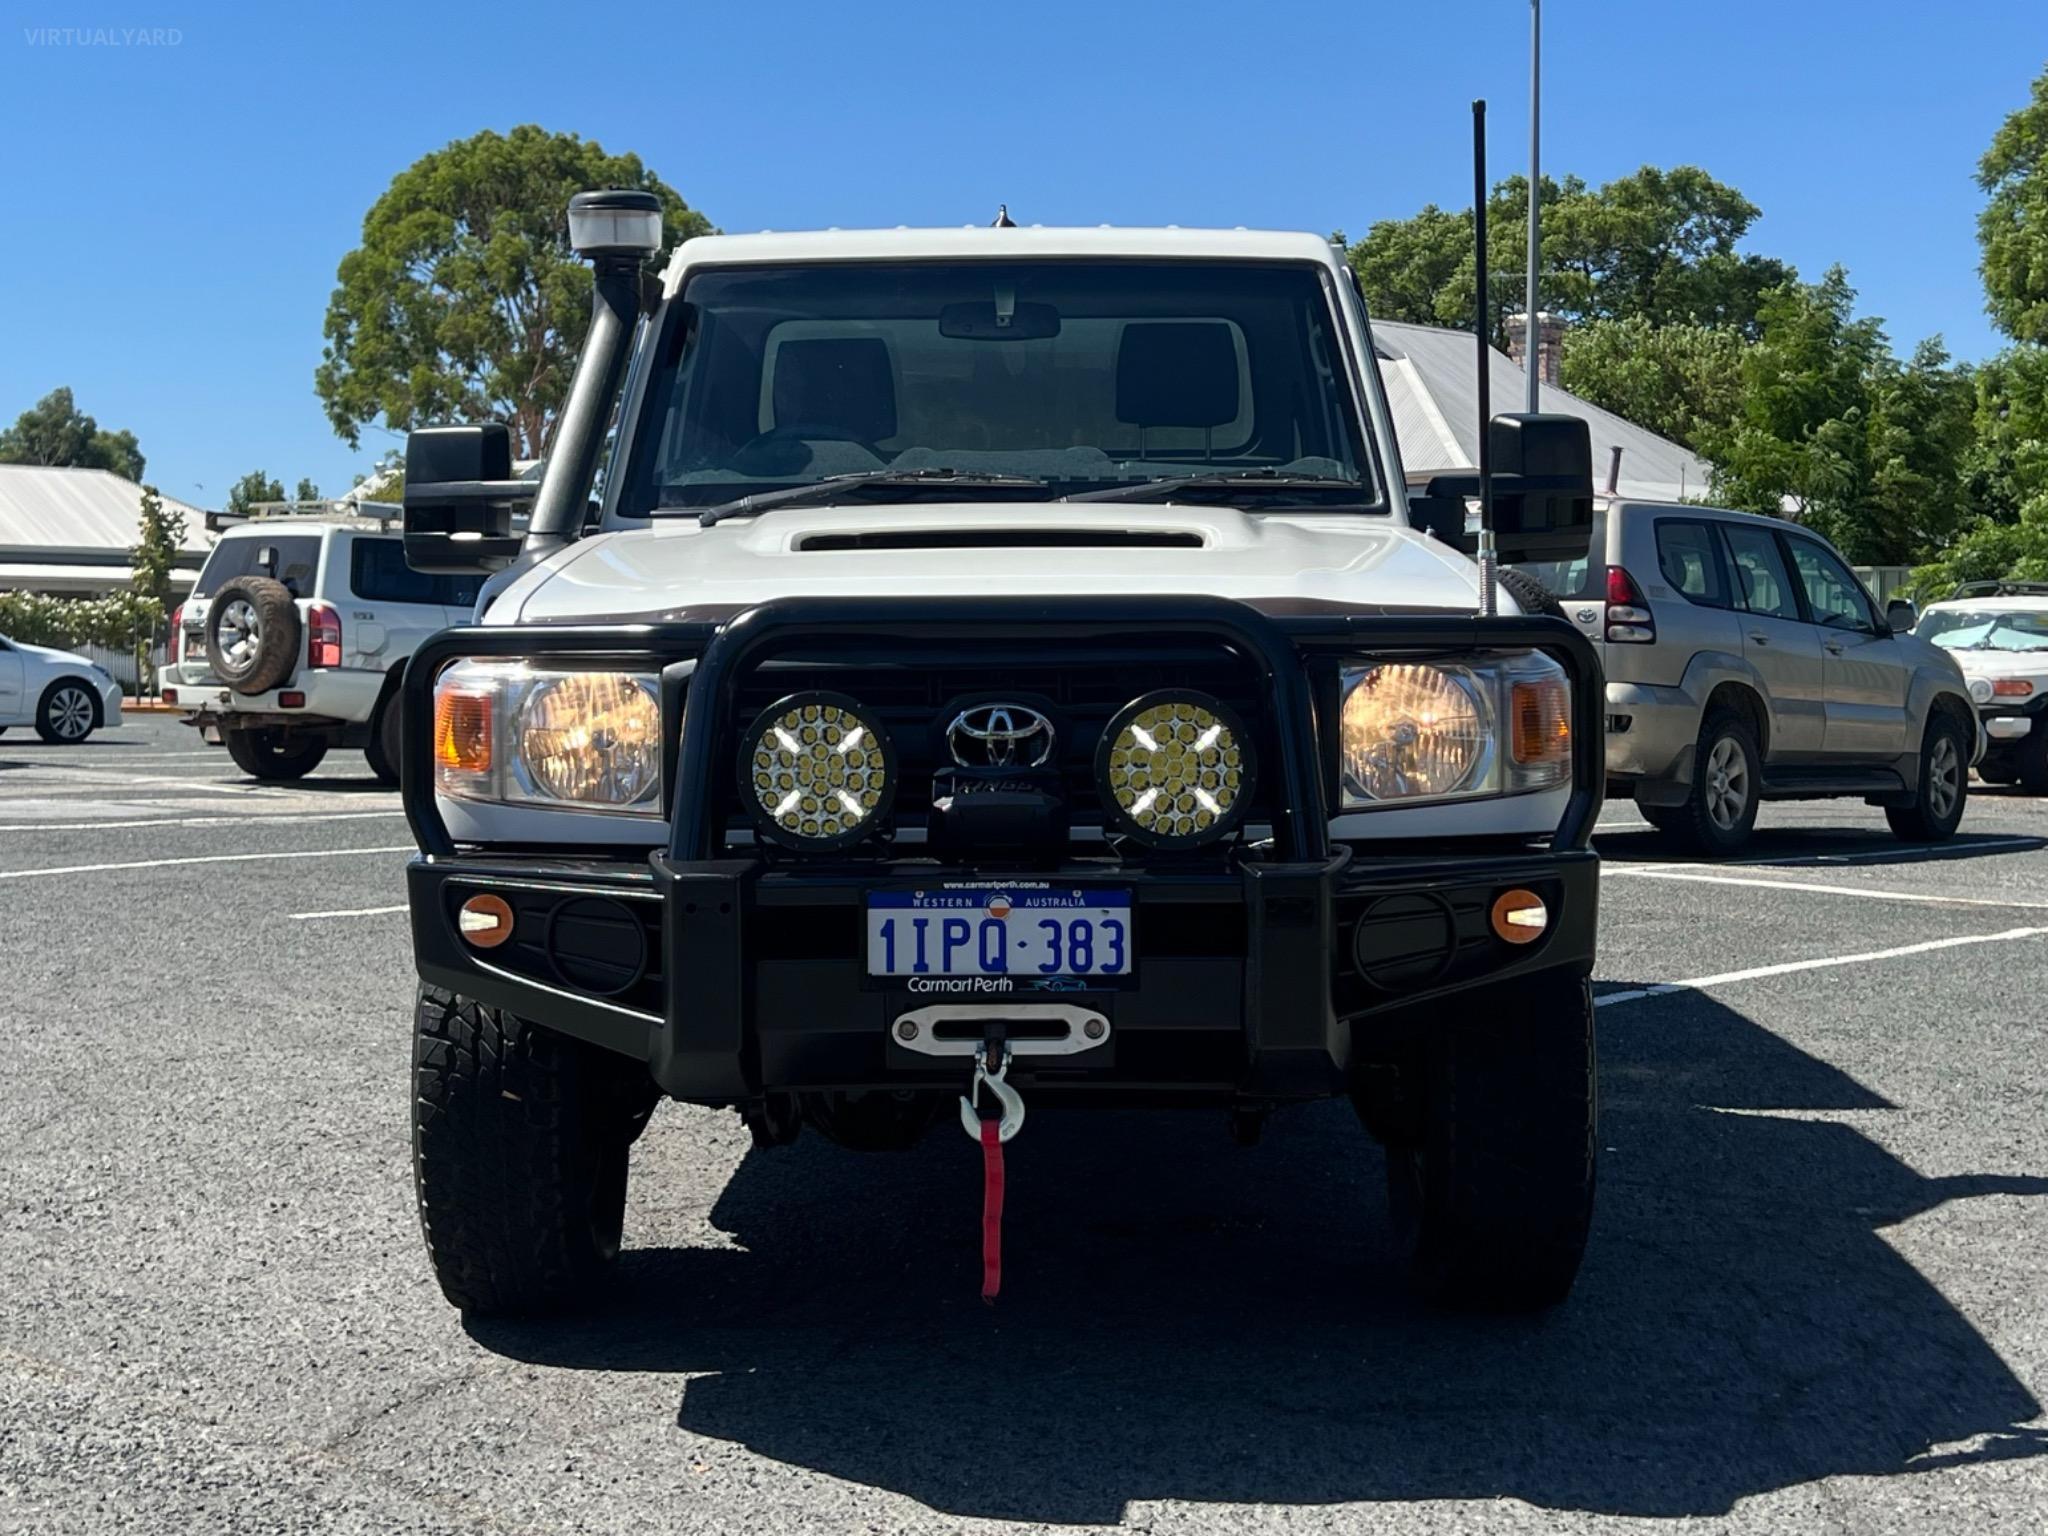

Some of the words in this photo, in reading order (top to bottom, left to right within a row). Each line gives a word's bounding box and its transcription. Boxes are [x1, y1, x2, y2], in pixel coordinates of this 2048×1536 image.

[943, 880, 1050, 890] www.carmartperth.com.au
[912, 898, 973, 907] WESTERN
[1025, 898, 1086, 907] AUSTRALIA
[908, 977, 972, 992] Carmart
[975, 977, 1013, 992] Perth
